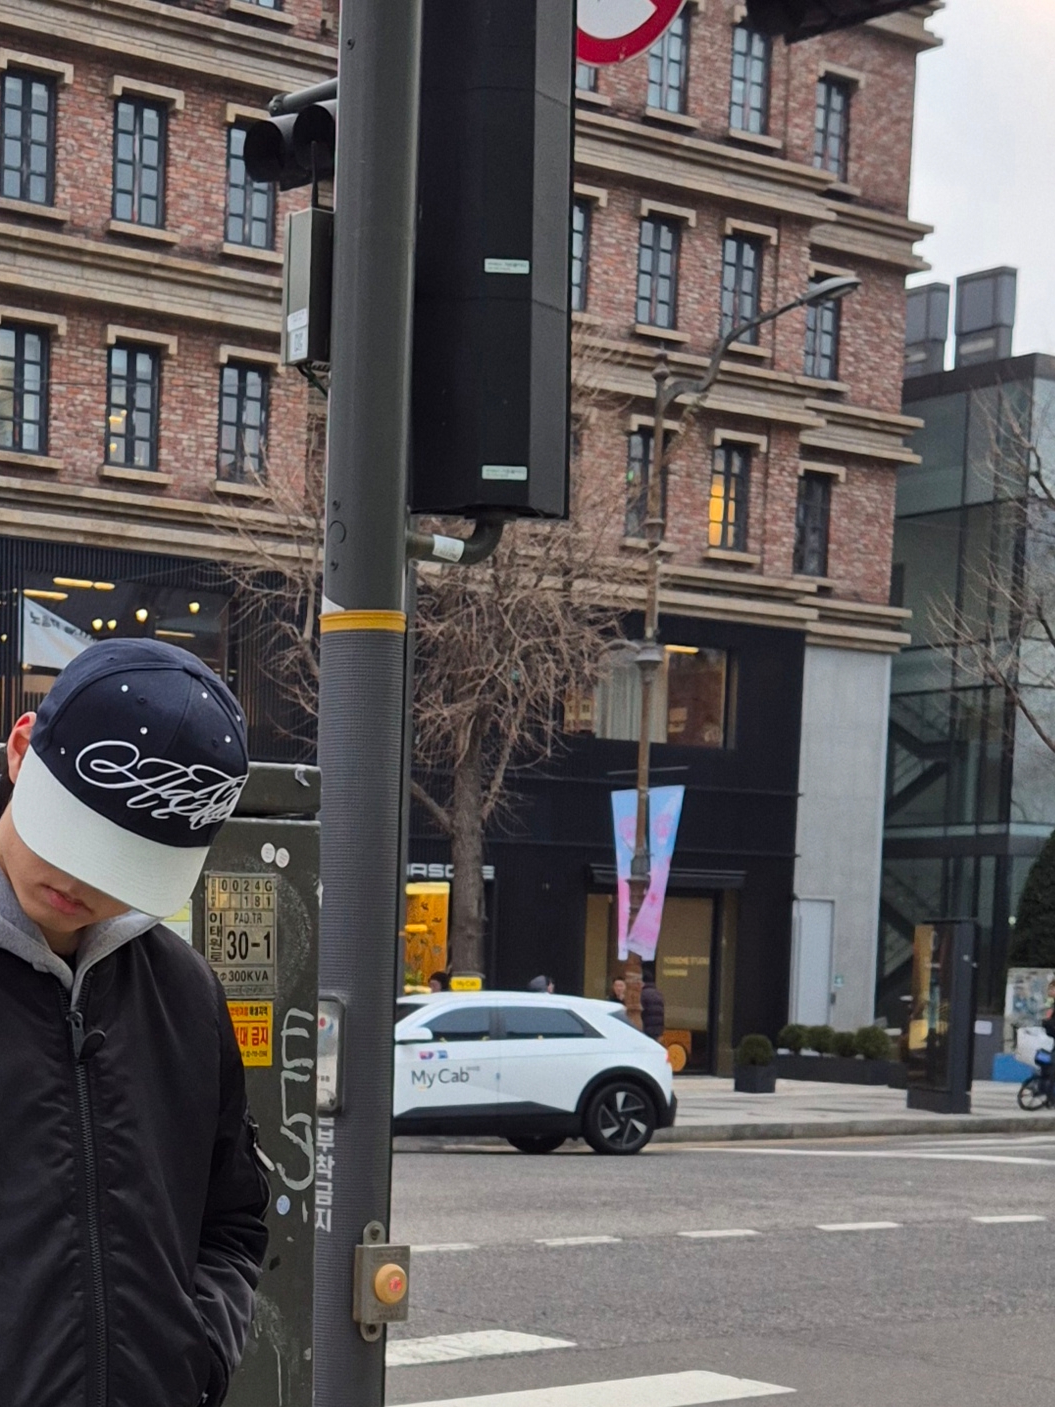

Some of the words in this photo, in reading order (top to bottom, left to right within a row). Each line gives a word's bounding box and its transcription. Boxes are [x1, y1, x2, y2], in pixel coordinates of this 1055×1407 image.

[233, 912, 263, 925] PAD.TR
[209, 912, 223, 963] 이태원로
[226, 930, 271, 960] 30-1
[251, 1026, 269, 1047] 금지
